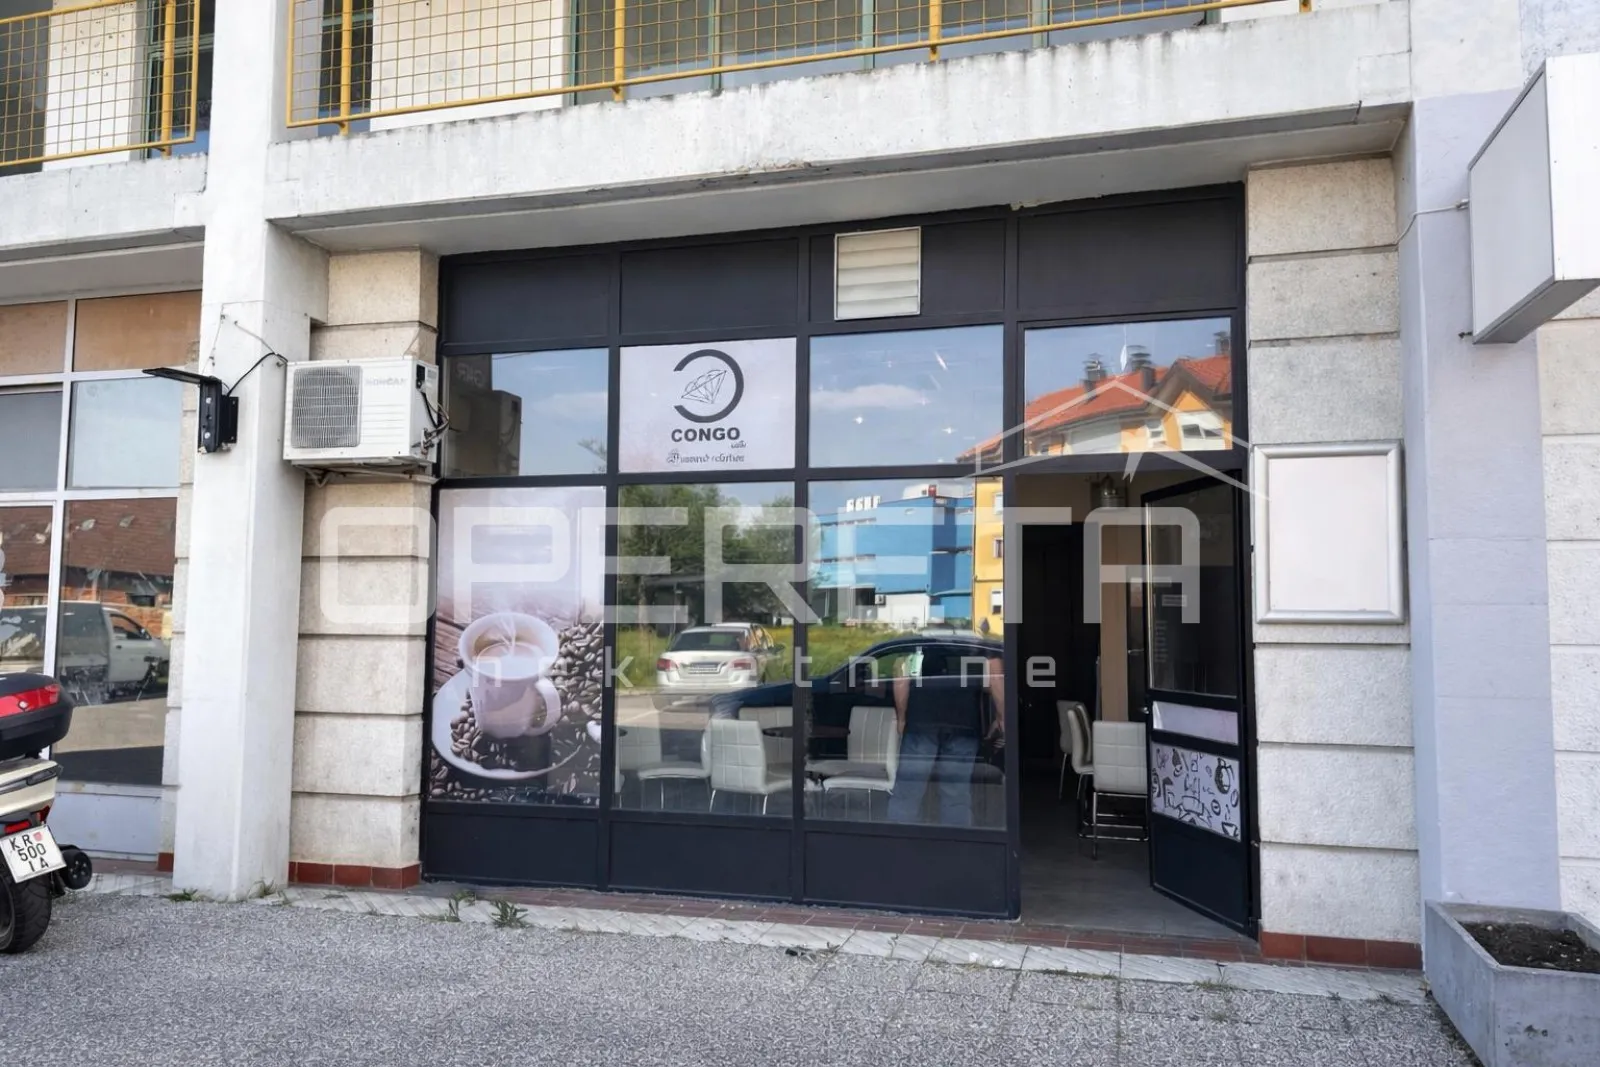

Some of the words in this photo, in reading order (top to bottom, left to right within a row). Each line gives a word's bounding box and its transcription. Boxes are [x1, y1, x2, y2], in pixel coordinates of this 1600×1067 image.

[671, 427, 741, 442] CONGO
[9, 834, 33, 851] KR
[17, 843, 46, 861] 500
